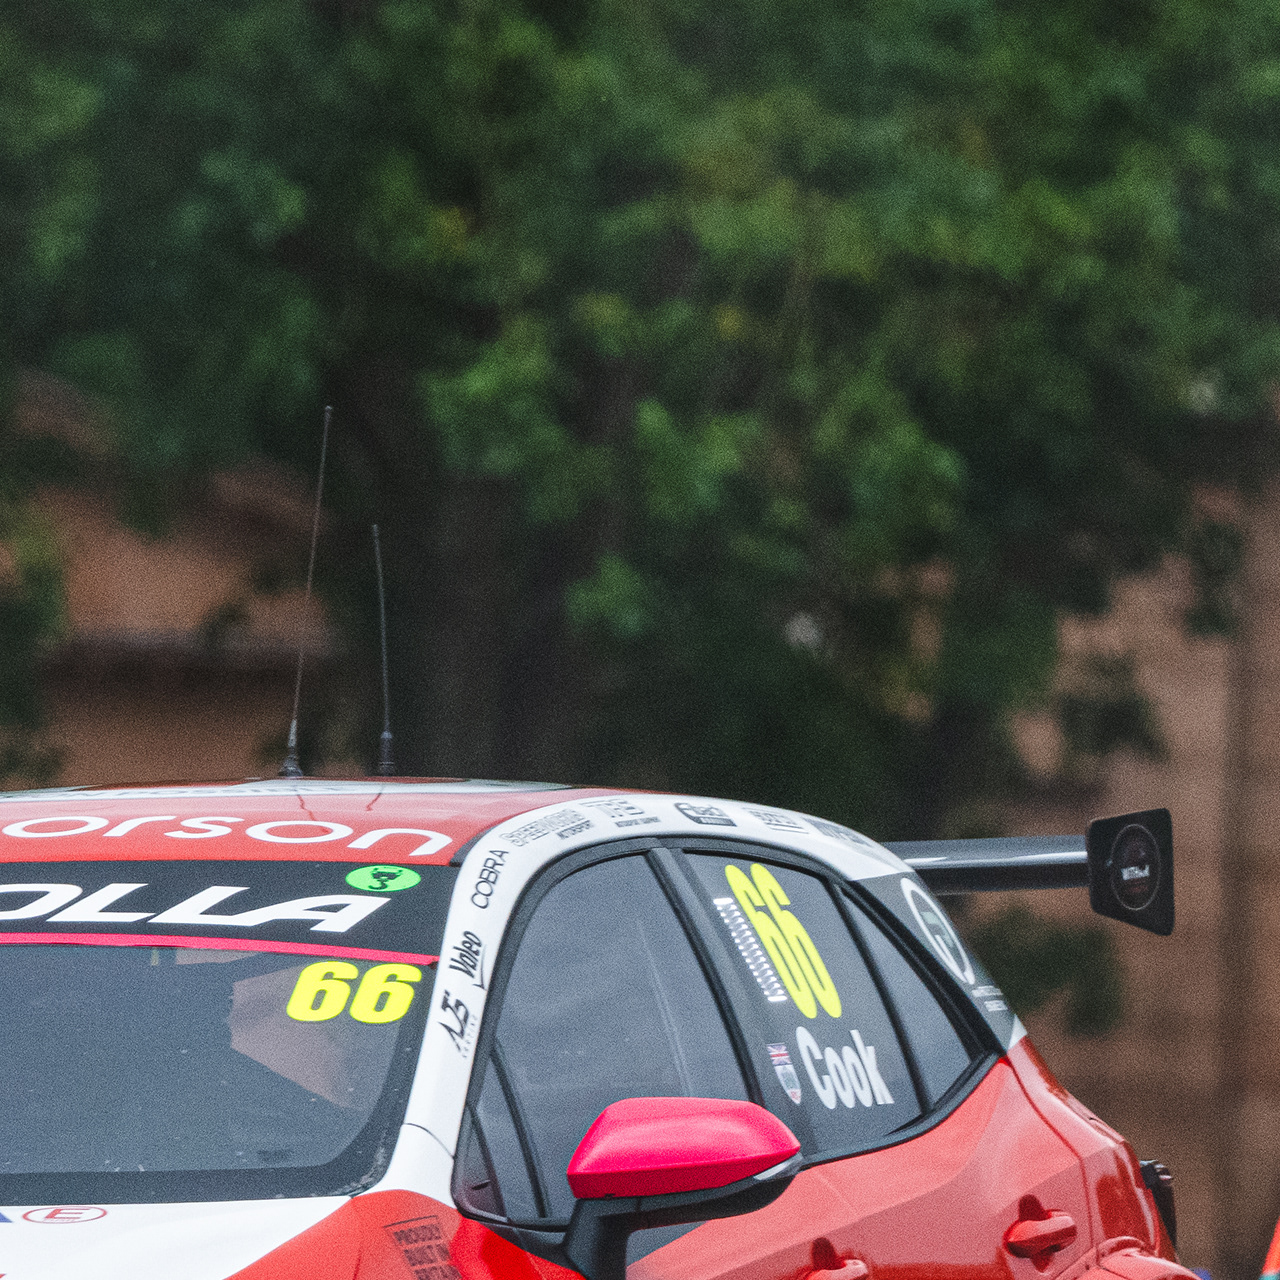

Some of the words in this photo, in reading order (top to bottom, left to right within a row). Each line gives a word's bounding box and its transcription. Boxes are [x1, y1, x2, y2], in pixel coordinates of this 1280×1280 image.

[471, 849, 509, 909] COBRA
[449, 930, 482, 979] Valeo
[725, 863, 842, 1019] 66
[286, 961, 423, 1024] 66
[796, 1026, 895, 1109] Cook
